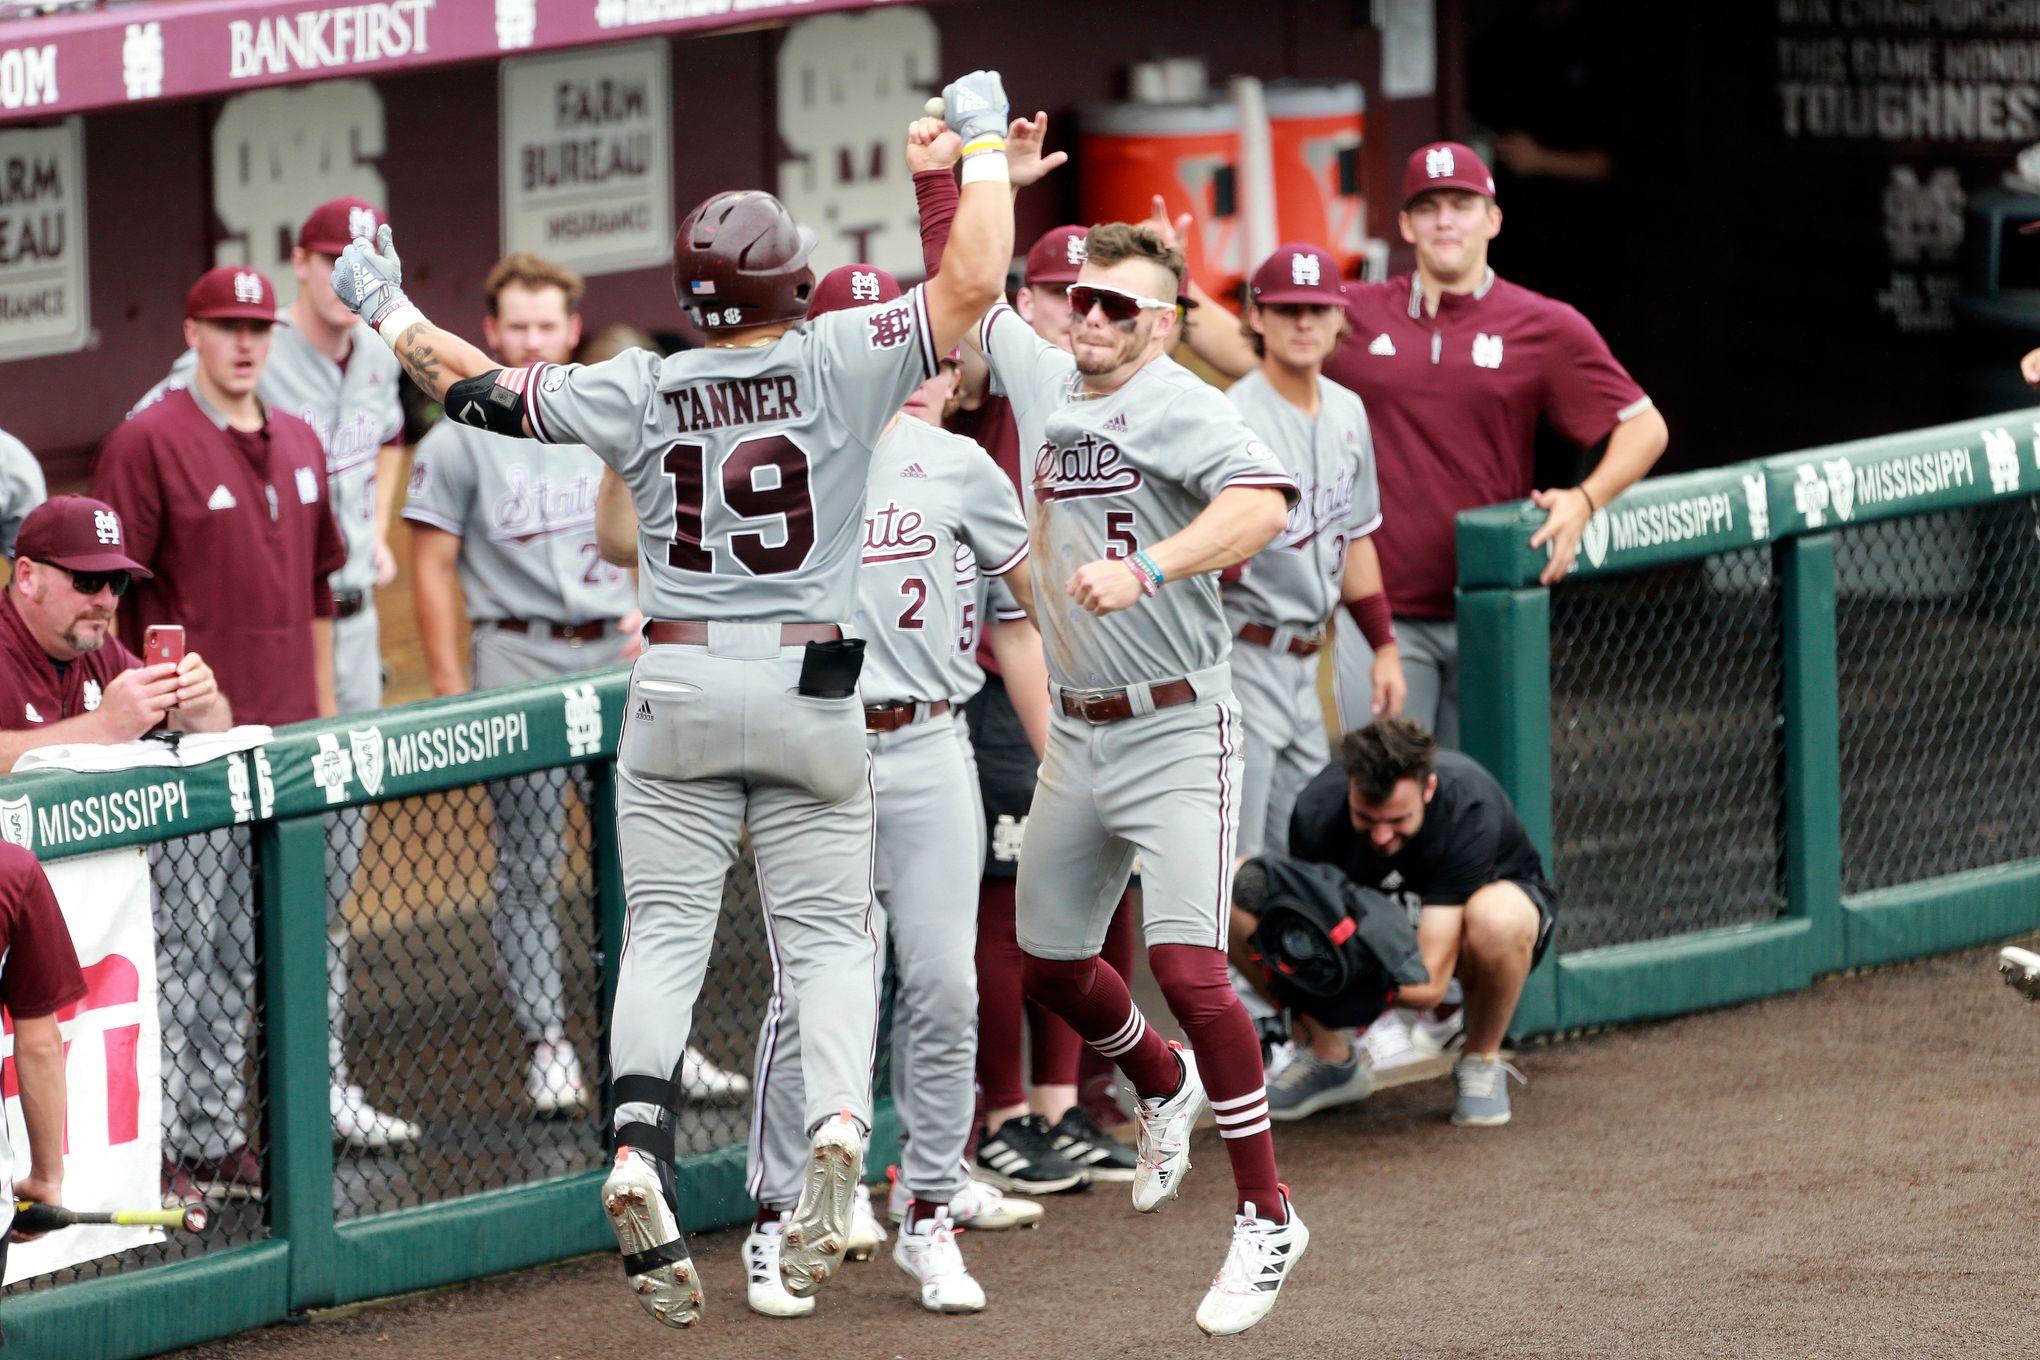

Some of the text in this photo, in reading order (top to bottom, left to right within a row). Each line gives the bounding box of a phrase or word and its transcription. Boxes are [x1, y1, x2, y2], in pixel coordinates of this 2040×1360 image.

[229, 1, 436, 78] BANKFIRST
[554, 77, 650, 131] FARM
[522, 133, 652, 192] BUREAU
[352, 263, 364, 301] adidas
[706, 312, 720, 326] 19
[664, 374, 803, 434] TANNER
[661, 431, 818, 577] 19
[1856, 447, 1974, 505] MISSISSIPPI
[864, 502, 937, 562] ate
[1105, 511, 1139, 560] 5
[1610, 491, 1734, 552] MISSISSIPPI
[898, 577, 928, 629] 2
[387, 711, 530, 778] MISSISSIPPI
[37, 779, 189, 847] MISSISSIPPI
